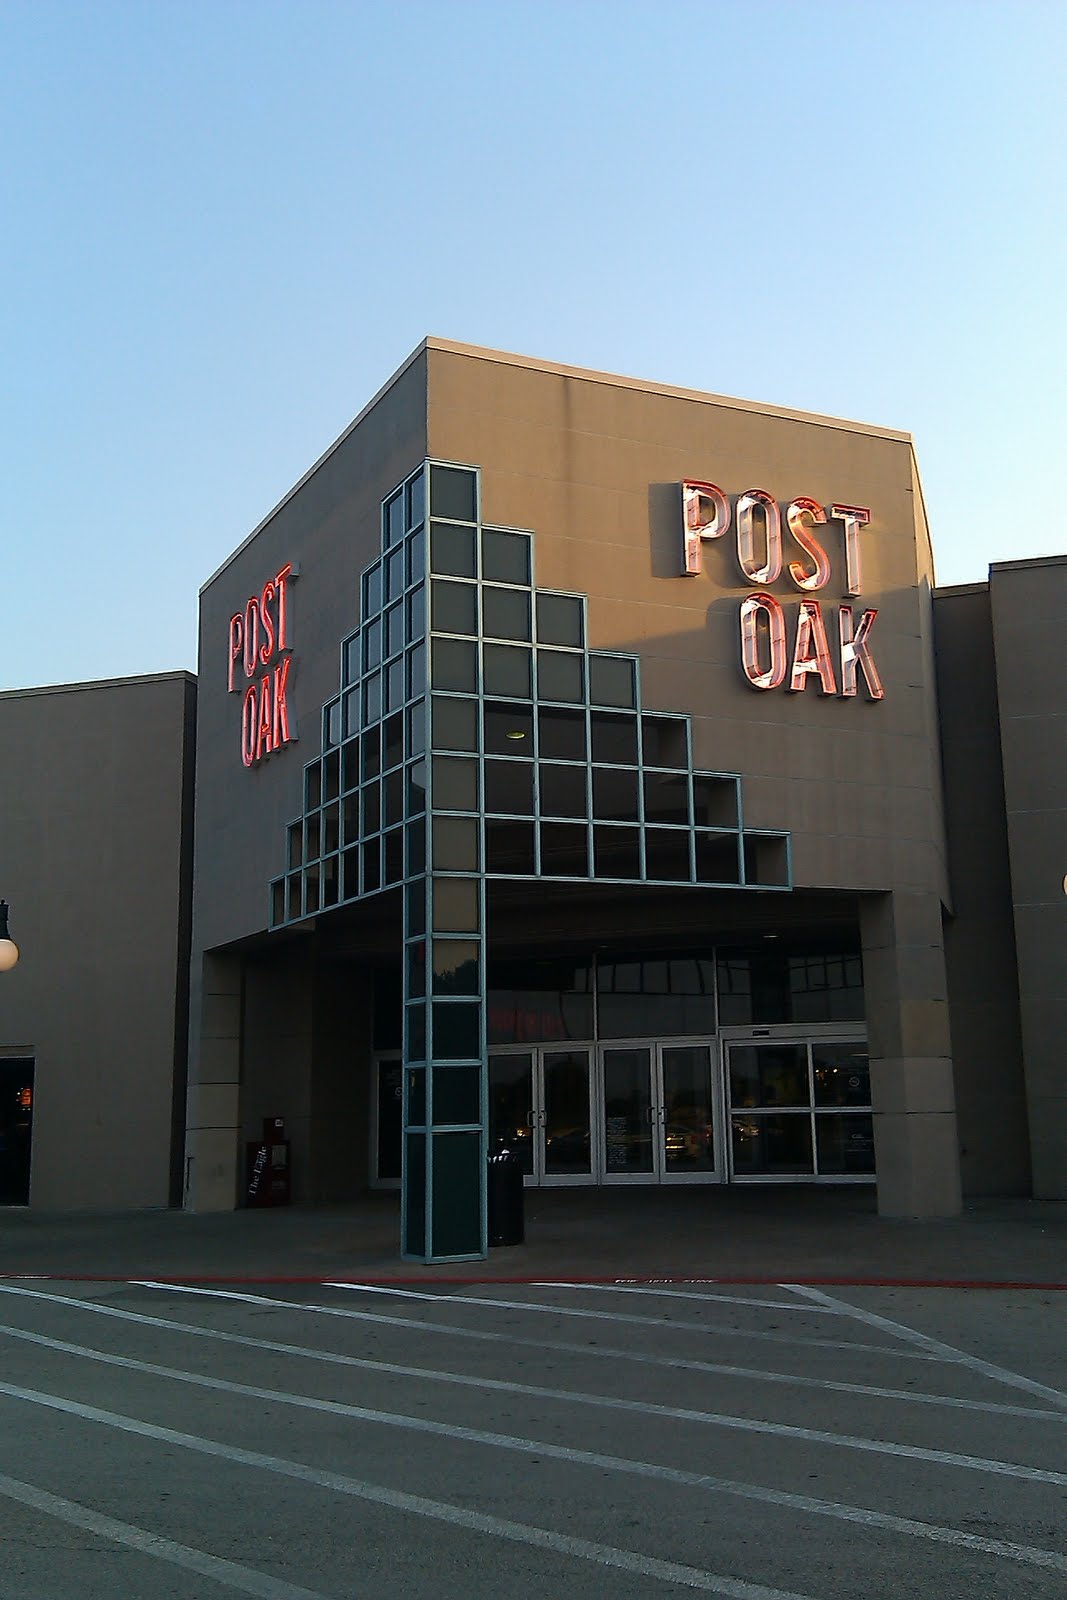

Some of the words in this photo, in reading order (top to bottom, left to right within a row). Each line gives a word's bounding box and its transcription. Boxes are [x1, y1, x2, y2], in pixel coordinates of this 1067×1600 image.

[681, 478, 872, 599] POST
[228, 561, 293, 692] POST
[740, 591, 885, 700] OAK
[242, 655, 291, 767] OAK
